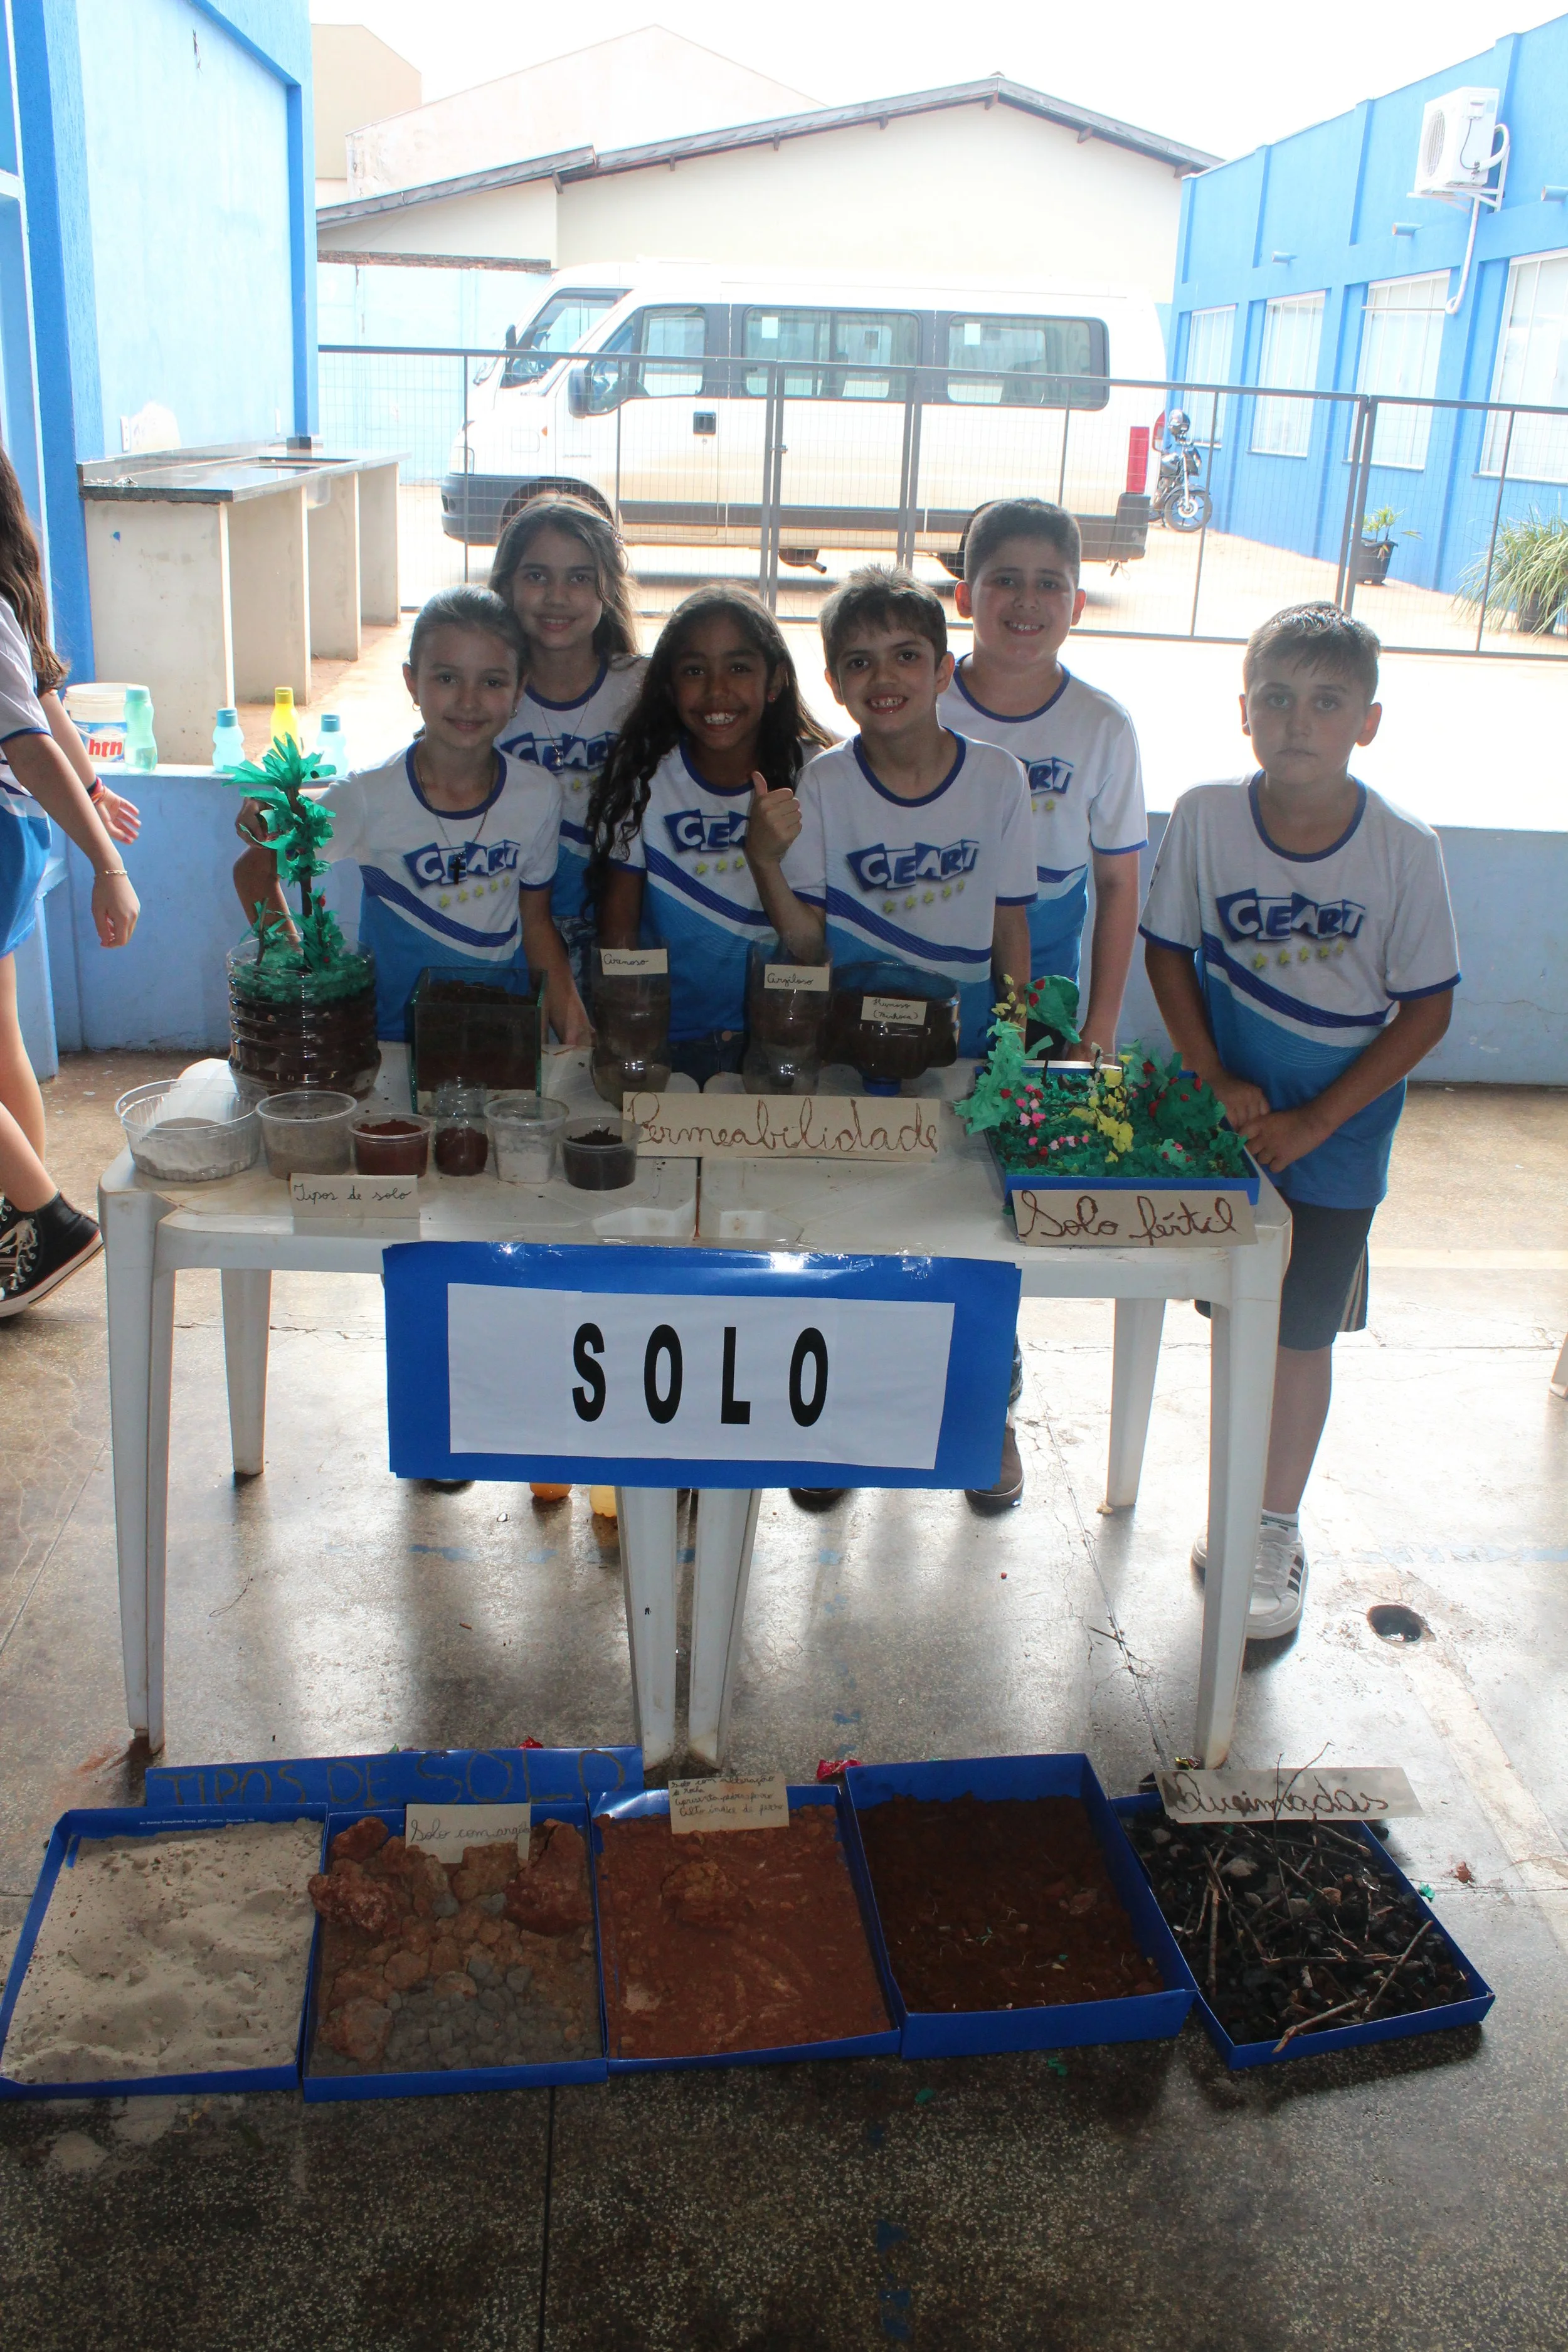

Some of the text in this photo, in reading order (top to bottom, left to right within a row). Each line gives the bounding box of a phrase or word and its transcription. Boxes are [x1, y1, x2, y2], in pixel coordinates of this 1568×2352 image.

[415, 845, 519, 882] CEART
[860, 842, 977, 885] CEART
[1228, 898, 1362, 937] CEART
[627, 1092, 937, 1152] Permeabilidade
[294, 1184, 411, 1204] Tipos de solo
[1019, 1190, 1241, 1246] Solo fértil
[572, 1323, 829, 1427] SOLO
[154, 1749, 626, 1808] TIPOS DE SOLO
[410, 1818, 450, 1842] Solo
[455, 1828, 489, 1839] com
